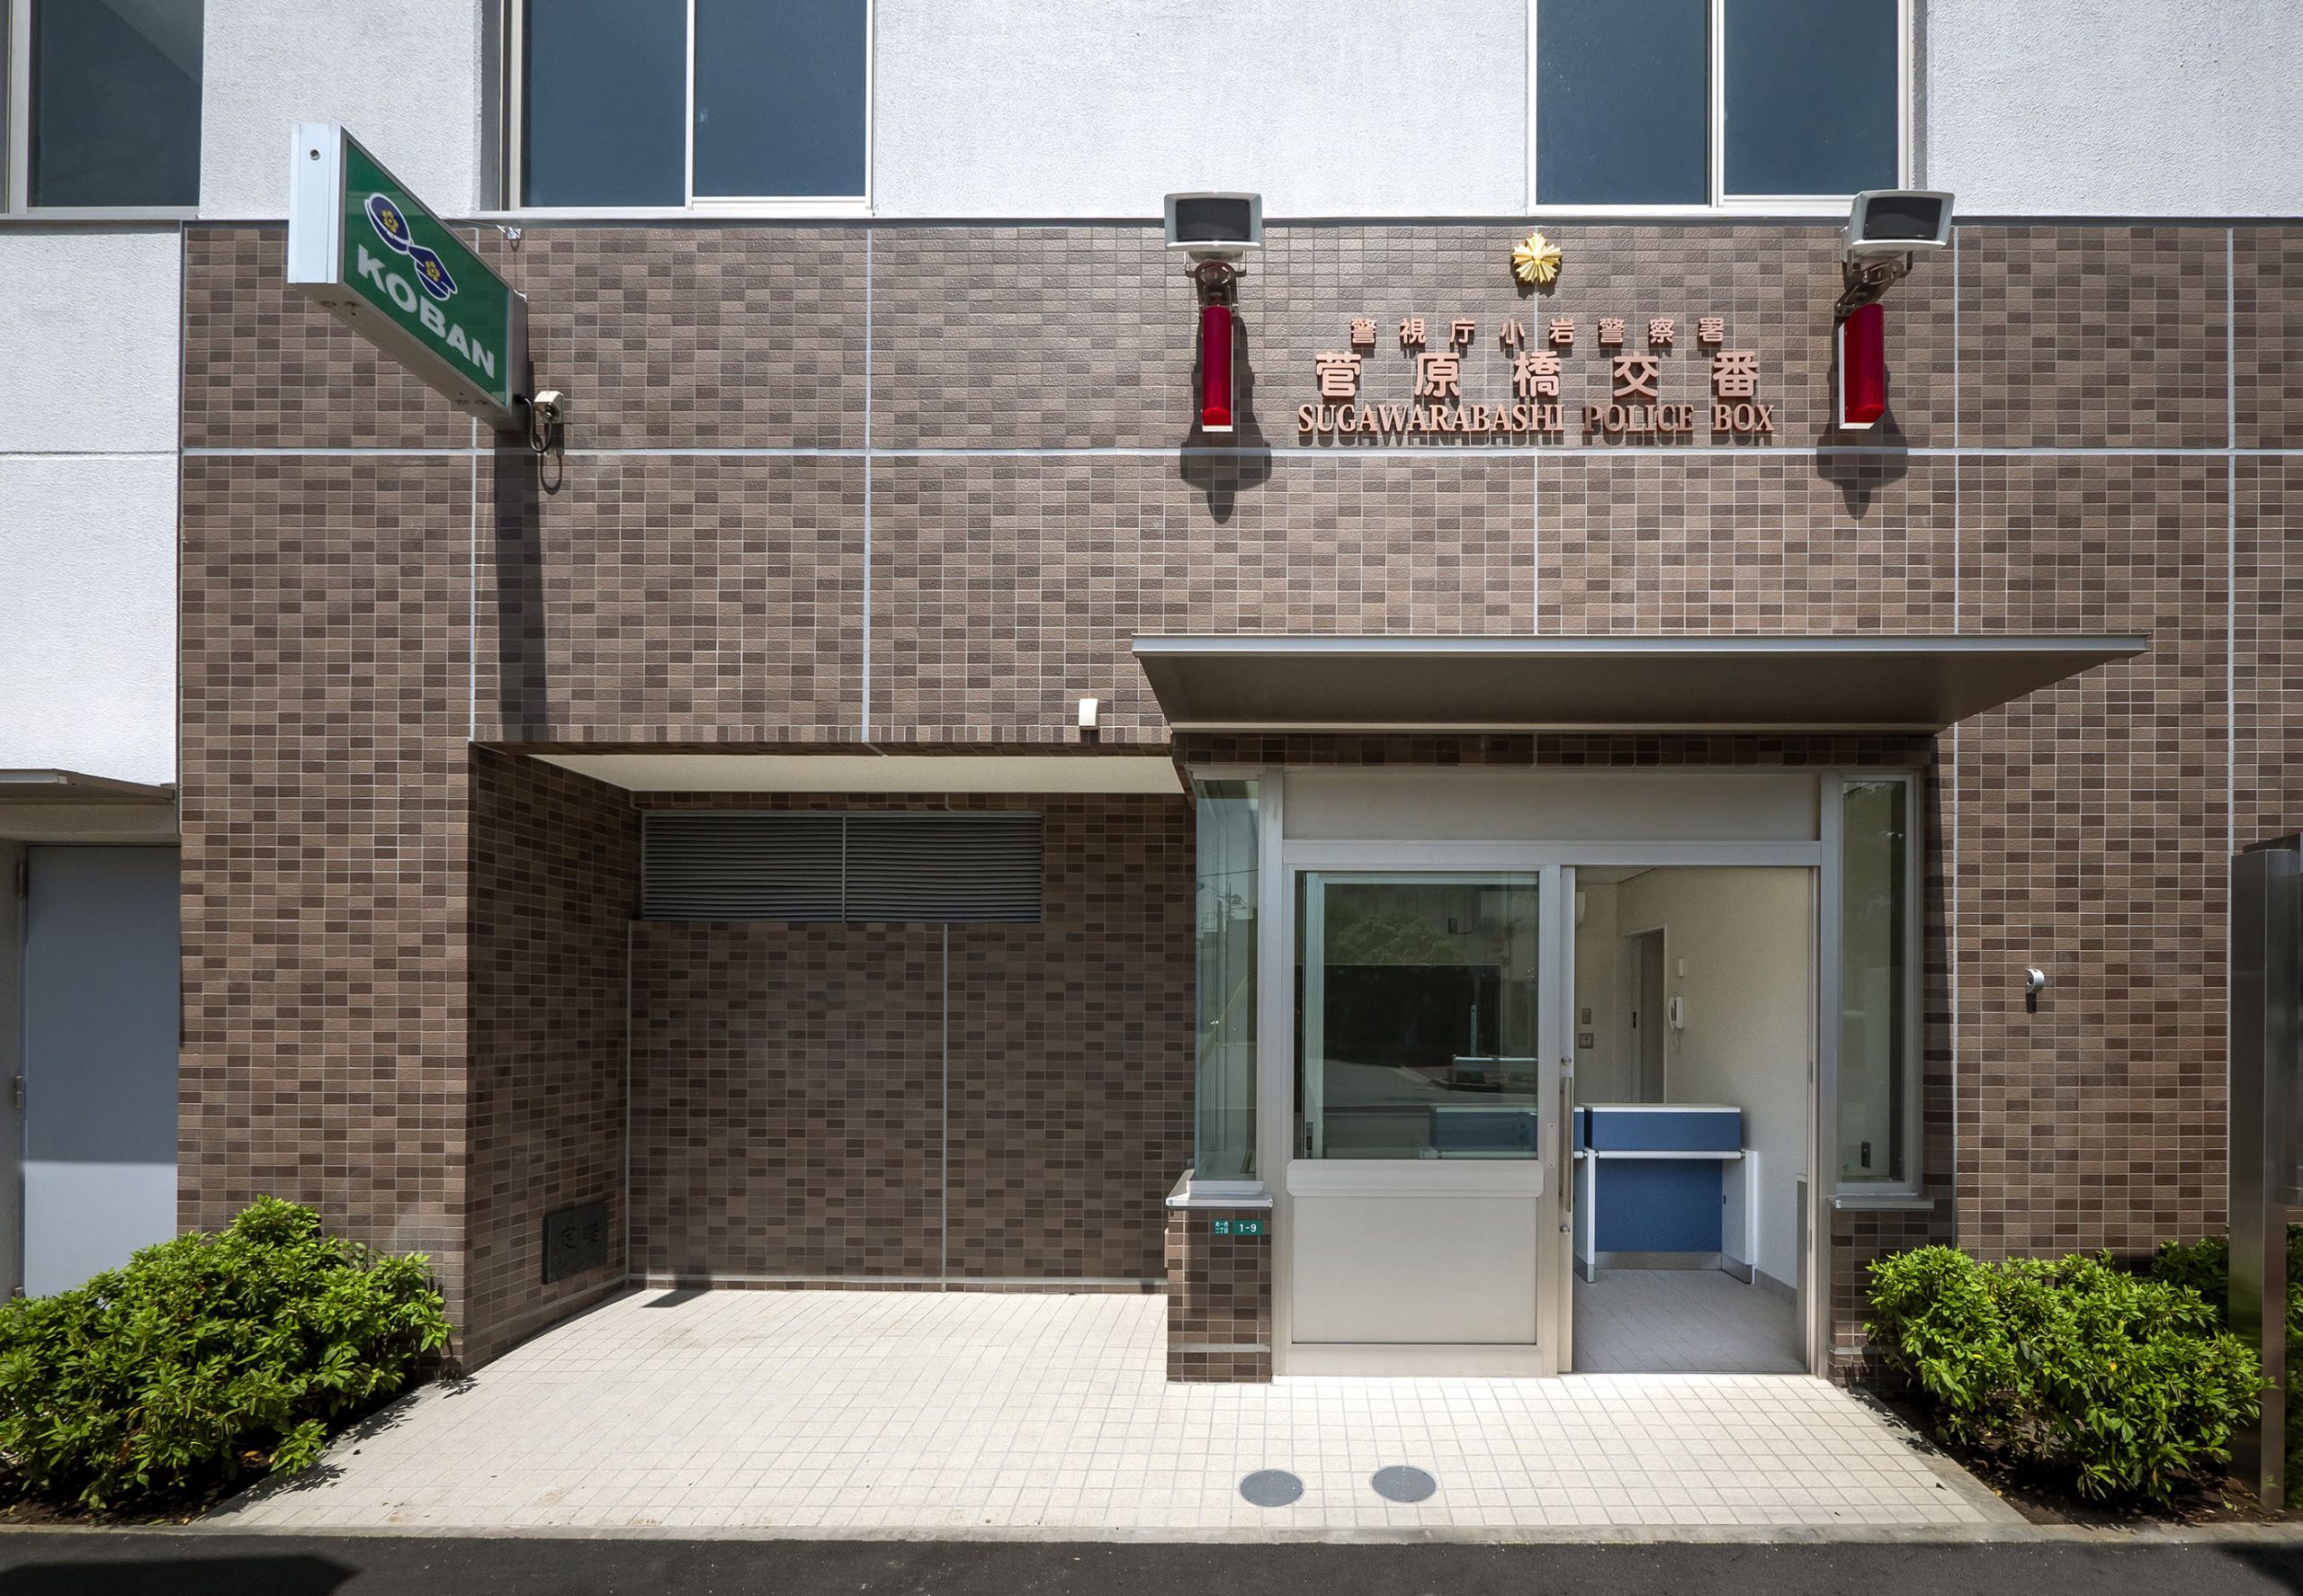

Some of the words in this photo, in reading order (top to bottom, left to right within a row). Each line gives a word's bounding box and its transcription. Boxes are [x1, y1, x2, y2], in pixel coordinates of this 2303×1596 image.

[357, 244, 495, 380] KOBAN
[1350, 317, 1725, 344] 警視庁小岩警察署
[1315, 351, 1760, 398] 菅原橋交番
[1297, 404, 1565, 433] SUGAWARABASHI
[1583, 404, 1694, 434] POLICE
[1712, 404, 1775, 433] BOX
[1239, 1224, 1257, 1233] 1-9
